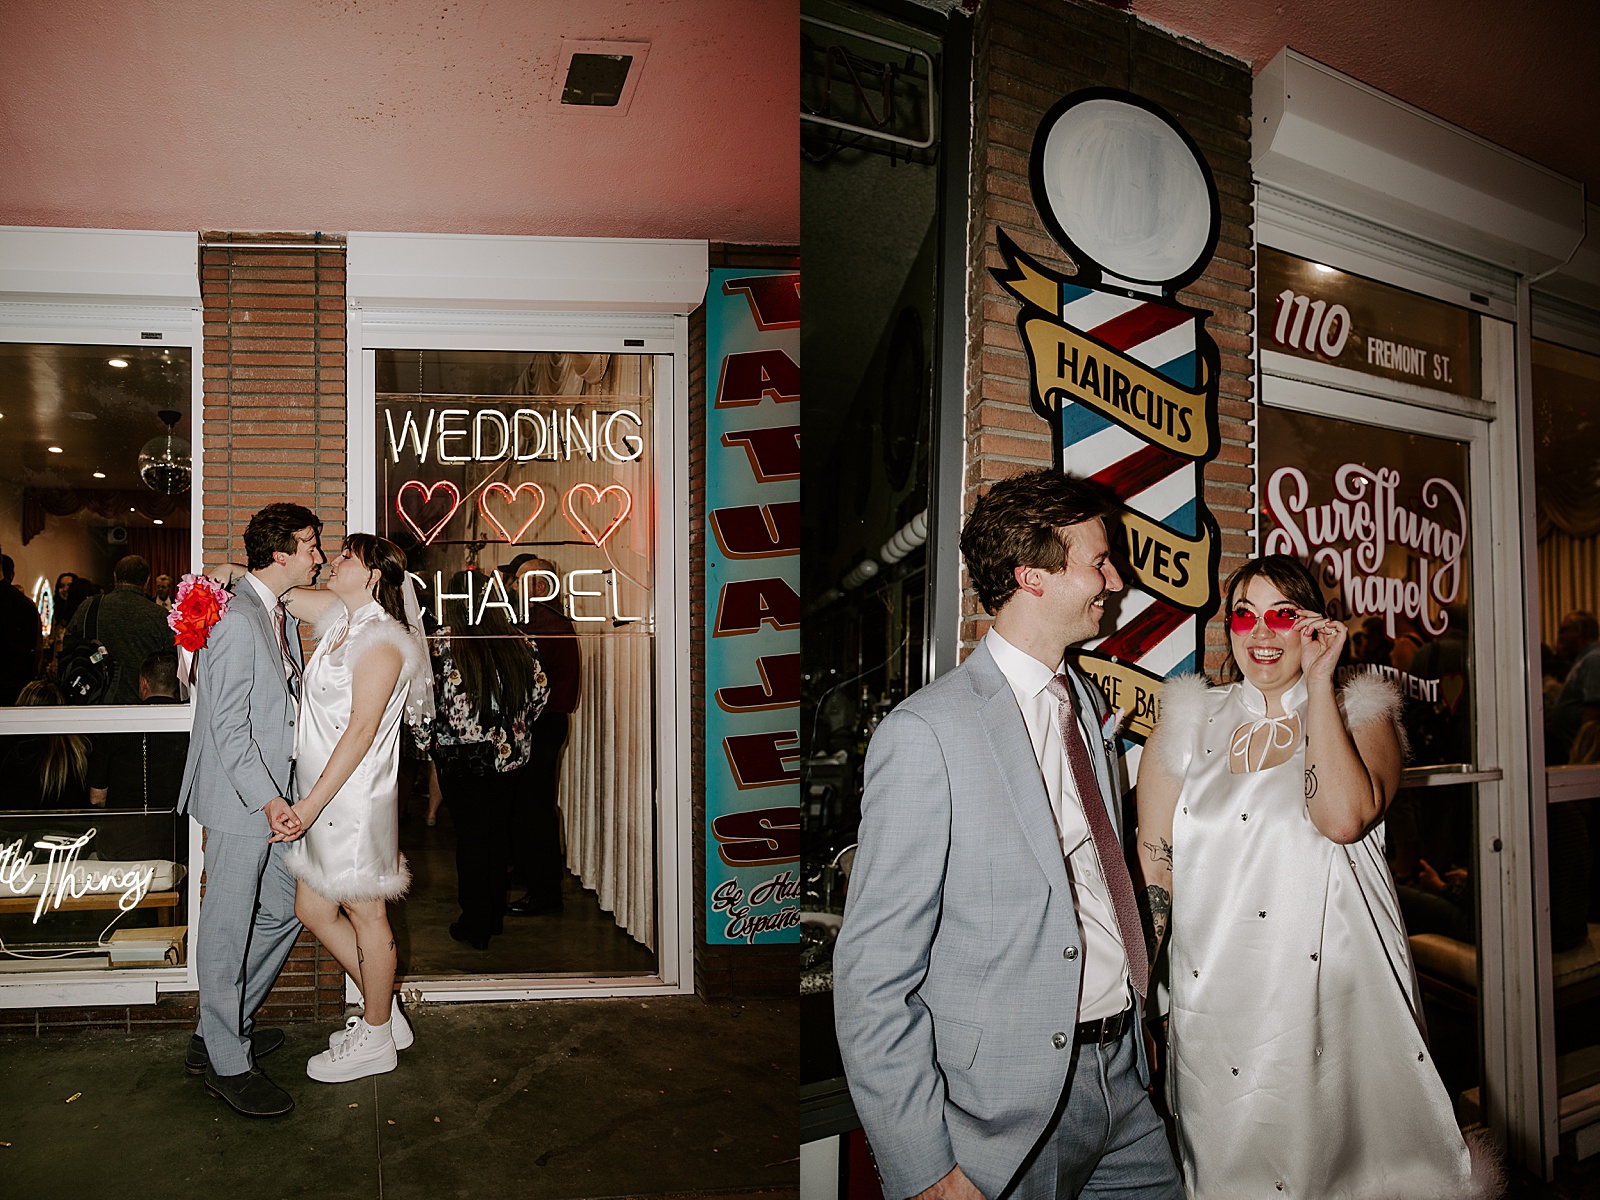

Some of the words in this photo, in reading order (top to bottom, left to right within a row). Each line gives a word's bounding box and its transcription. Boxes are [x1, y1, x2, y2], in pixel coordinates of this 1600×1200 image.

[1270, 289, 1351, 360] 1110
[1367, 336, 1427, 377] FREMONT
[1433, 353, 1453, 383] ST.
[385, 408, 644, 463] WEDDING
[1056, 341, 1193, 443] HAIRCUTS
[1264, 466, 1376, 566] Sure
[1334, 463, 1467, 603] Thing
[32, 834, 155, 924] Thing
[711, 876, 745, 913] Se
